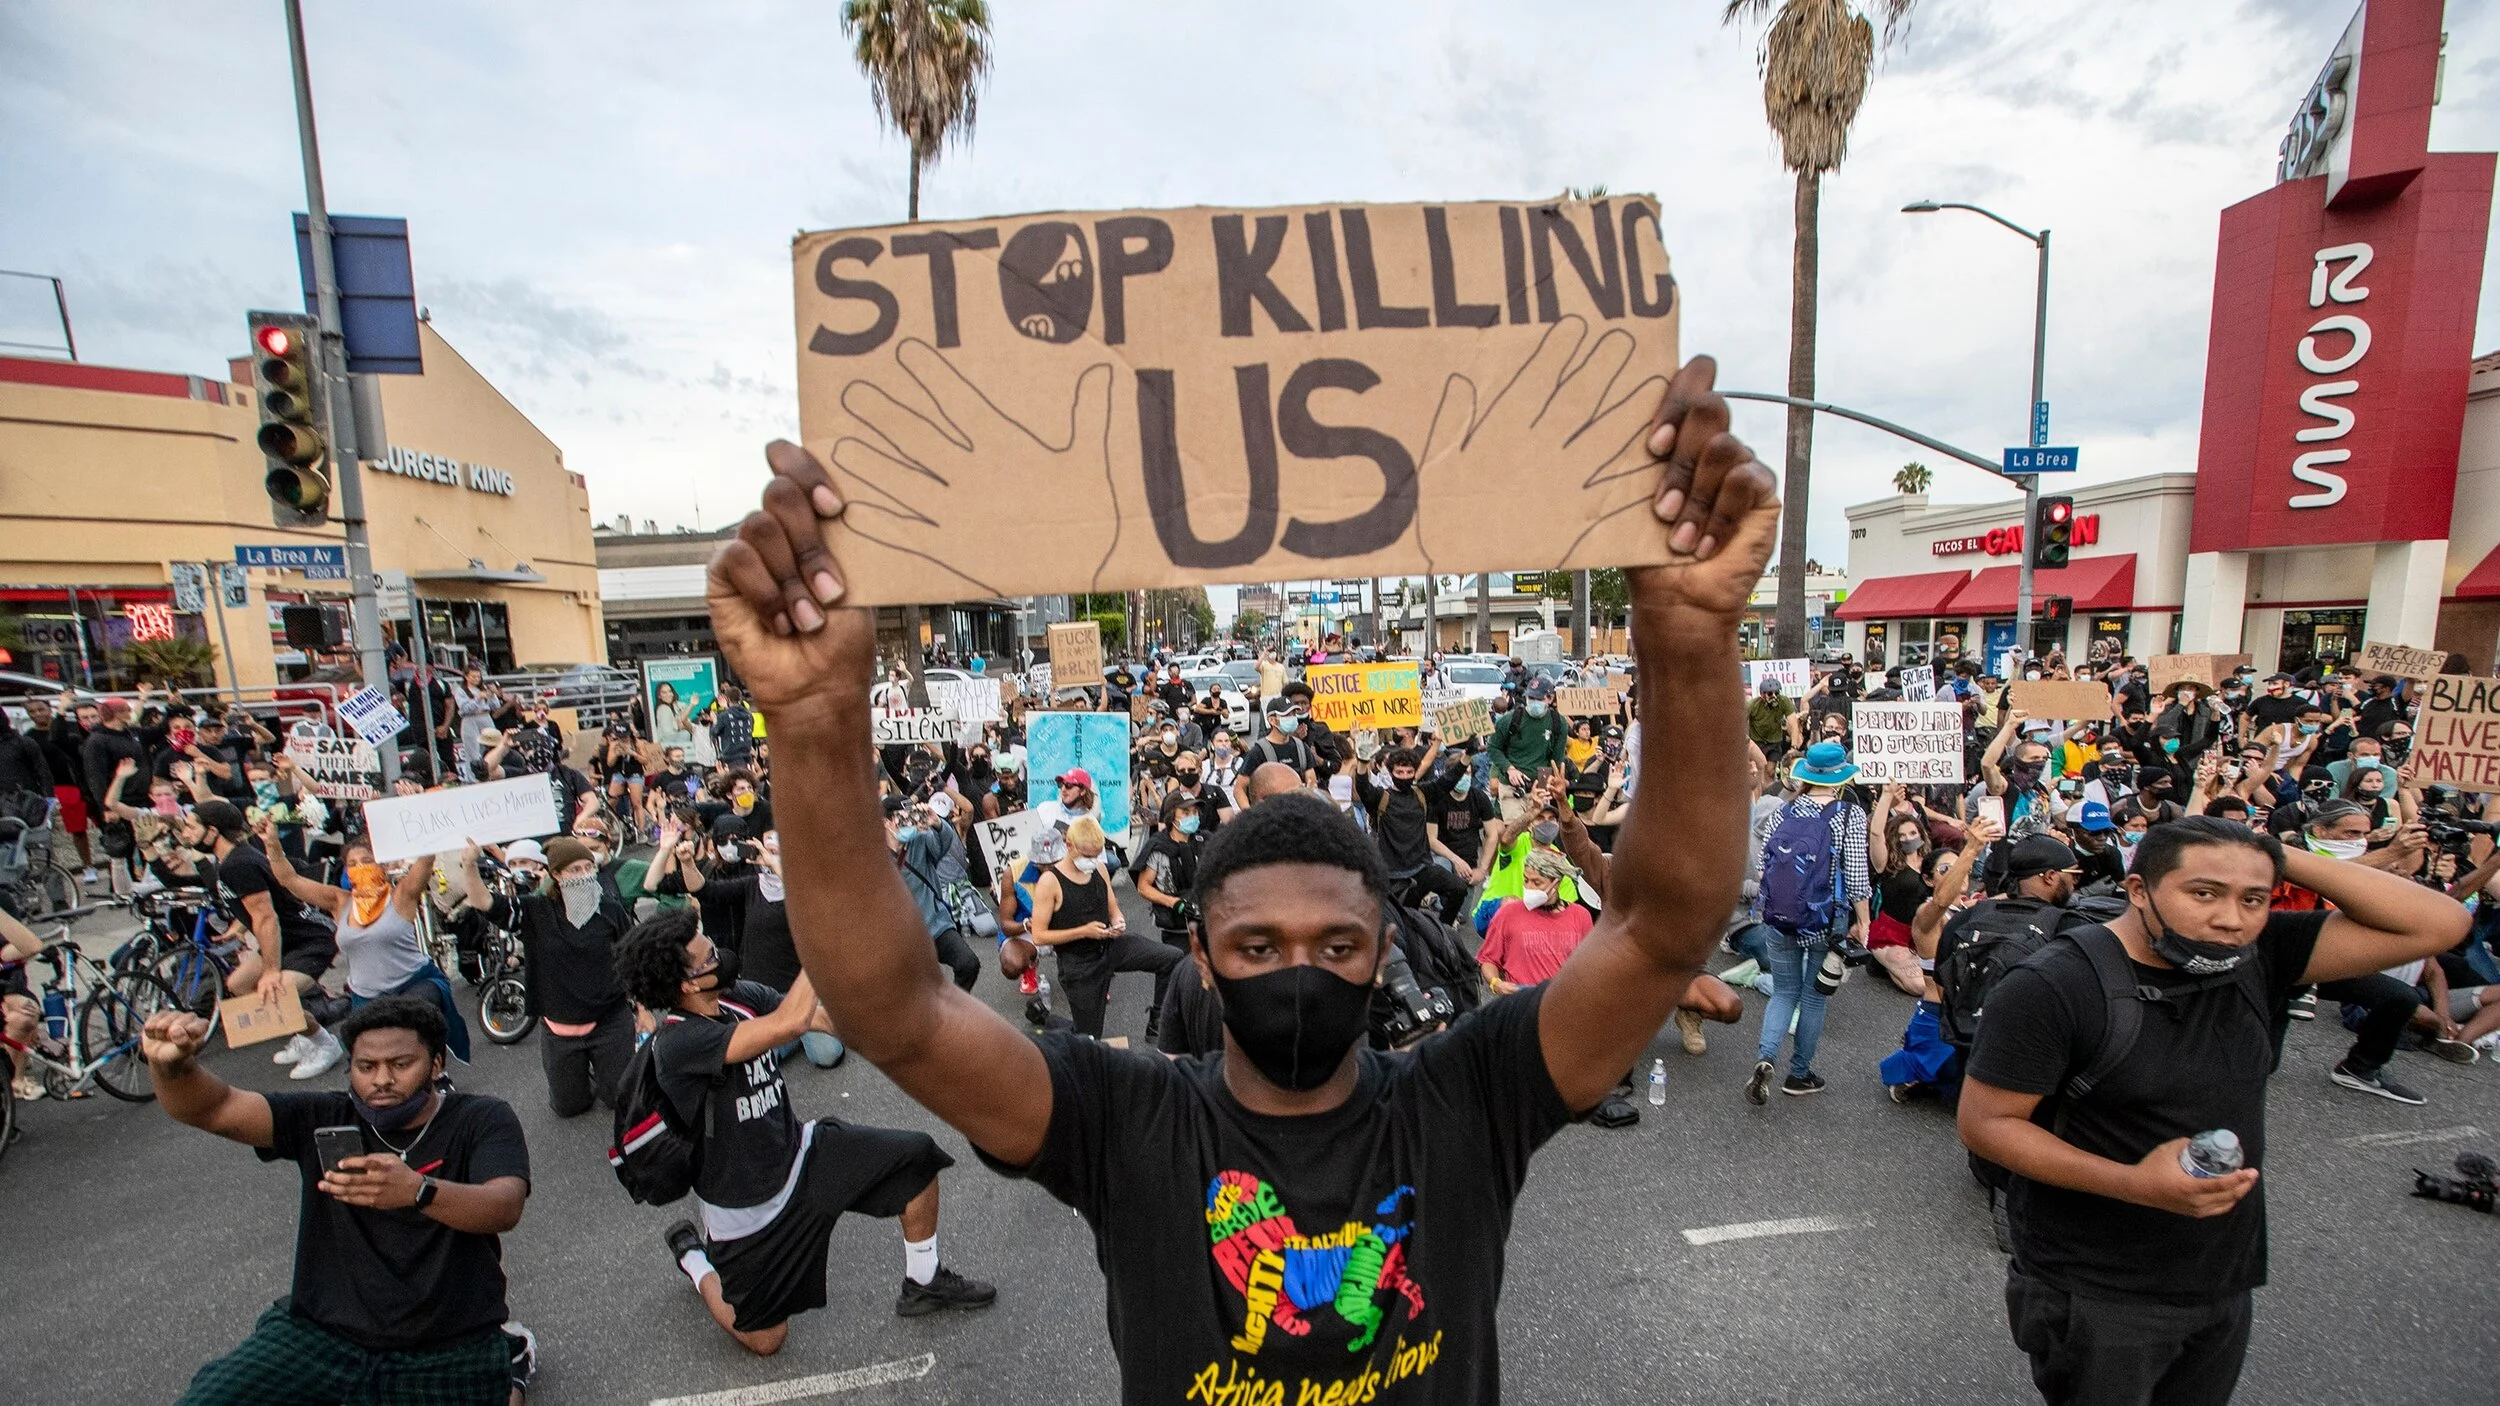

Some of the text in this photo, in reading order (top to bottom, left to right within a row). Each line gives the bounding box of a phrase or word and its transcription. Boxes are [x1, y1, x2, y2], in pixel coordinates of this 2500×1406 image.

[809, 200, 1678, 356] STOP KILLING
[2288, 242, 2374, 510] ROSS
[1136, 358, 1419, 569] US
[2013, 452, 2069, 467] La Brea
[468, 462, 516, 497] KING
[1851, 528, 1867, 540] 7070
[246, 548, 332, 565] La Brea Av
[1934, 538, 1978, 554] TACOS EL
[1056, 629, 1095, 646] FUCK
[2169, 656, 2211, 670] JUSTICE
[2367, 645, 2446, 667] BLACK LIVES
[1764, 662, 1792, 673] STOP
[2372, 660, 2428, 675] MATTER
[1311, 669, 1420, 695] JUSTICE REFORM
[2430, 678, 2500, 713] BLAC
[1310, 698, 1348, 720] DEATH
[1353, 699, 1376, 716] NOT
[1435, 700, 1487, 726] DEFUND
[1442, 717, 1491, 743] POLICE
[1856, 711, 1962, 731] DEFUND LAPD
[1858, 733, 1962, 754] NO JUSTICE
[2424, 716, 2500, 750] LIVE
[318, 740, 357, 755] SAY
[1862, 758, 1953, 778] NO PEACE
[2414, 749, 2500, 785] MATTE
[400, 806, 456, 842] BLACK
[460, 799, 501, 824] LIVES
[987, 821, 1017, 850] Bye
[995, 850, 1020, 867] Bye
